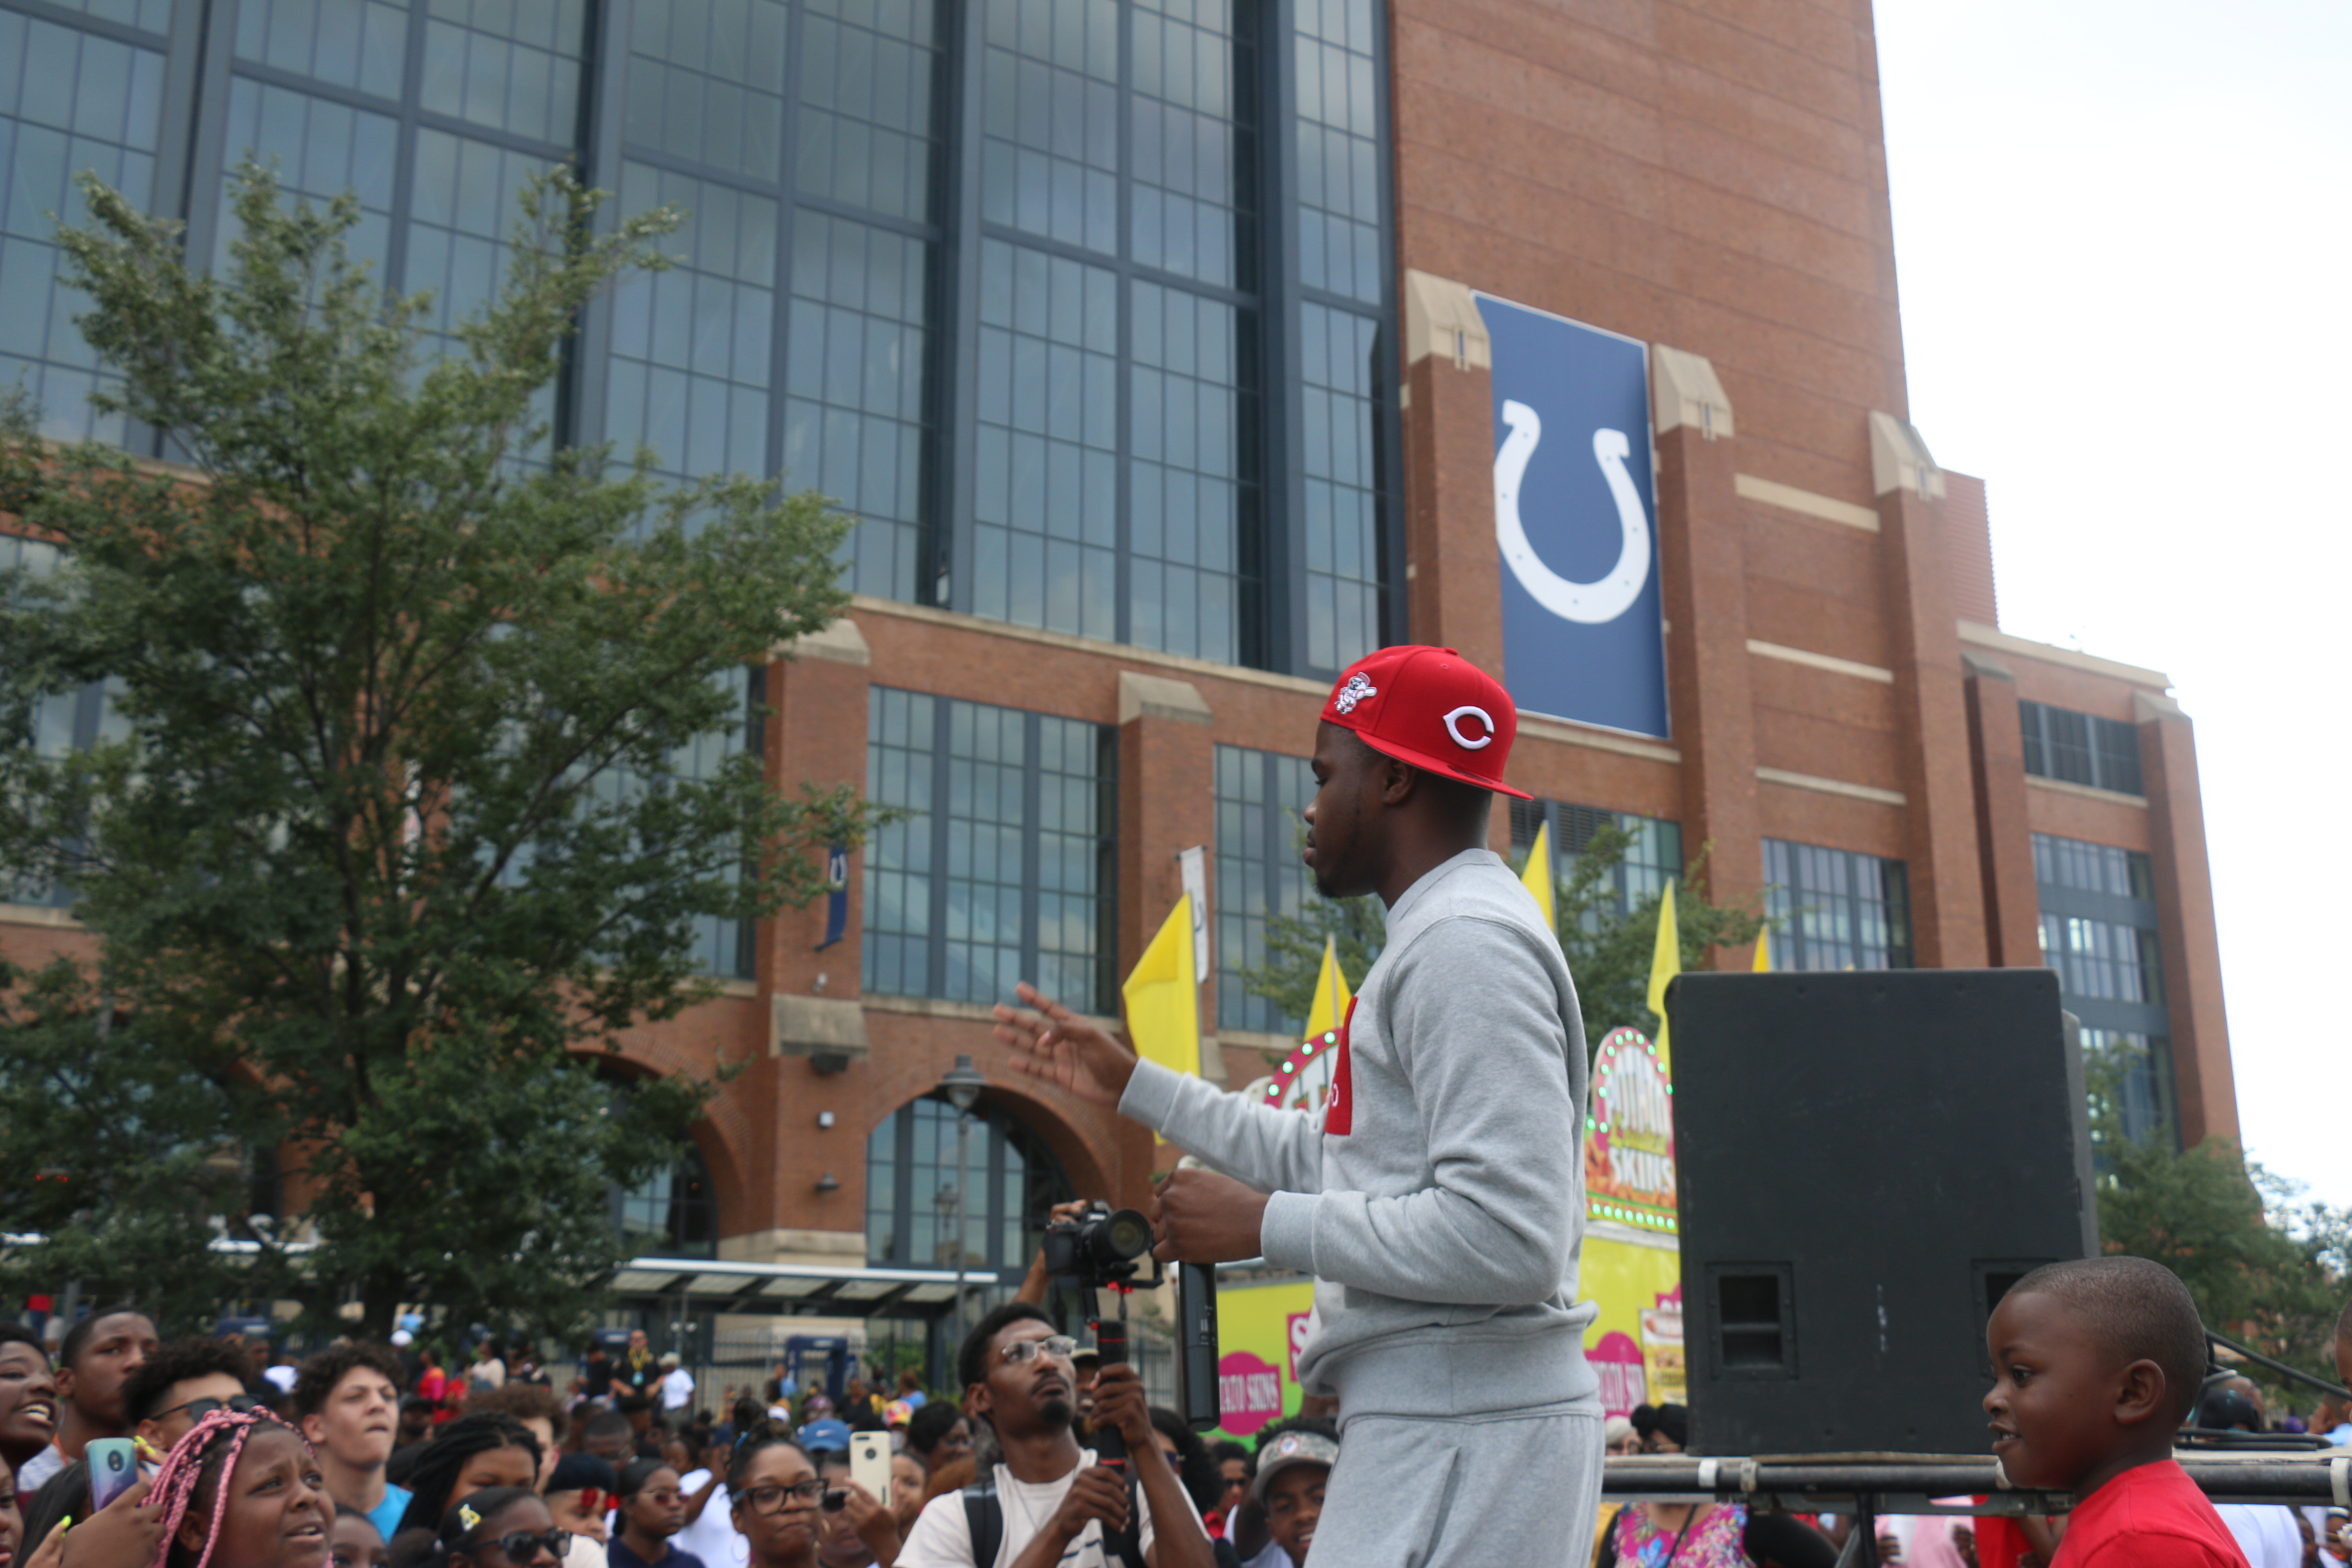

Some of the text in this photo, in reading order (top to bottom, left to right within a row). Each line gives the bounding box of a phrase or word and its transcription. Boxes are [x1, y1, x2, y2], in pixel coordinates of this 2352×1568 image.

[1442, 705, 1494, 750] C
[1608, 1145, 1676, 1194] SKINS
[1219, 1372, 1279, 1414] TATO SKINS
